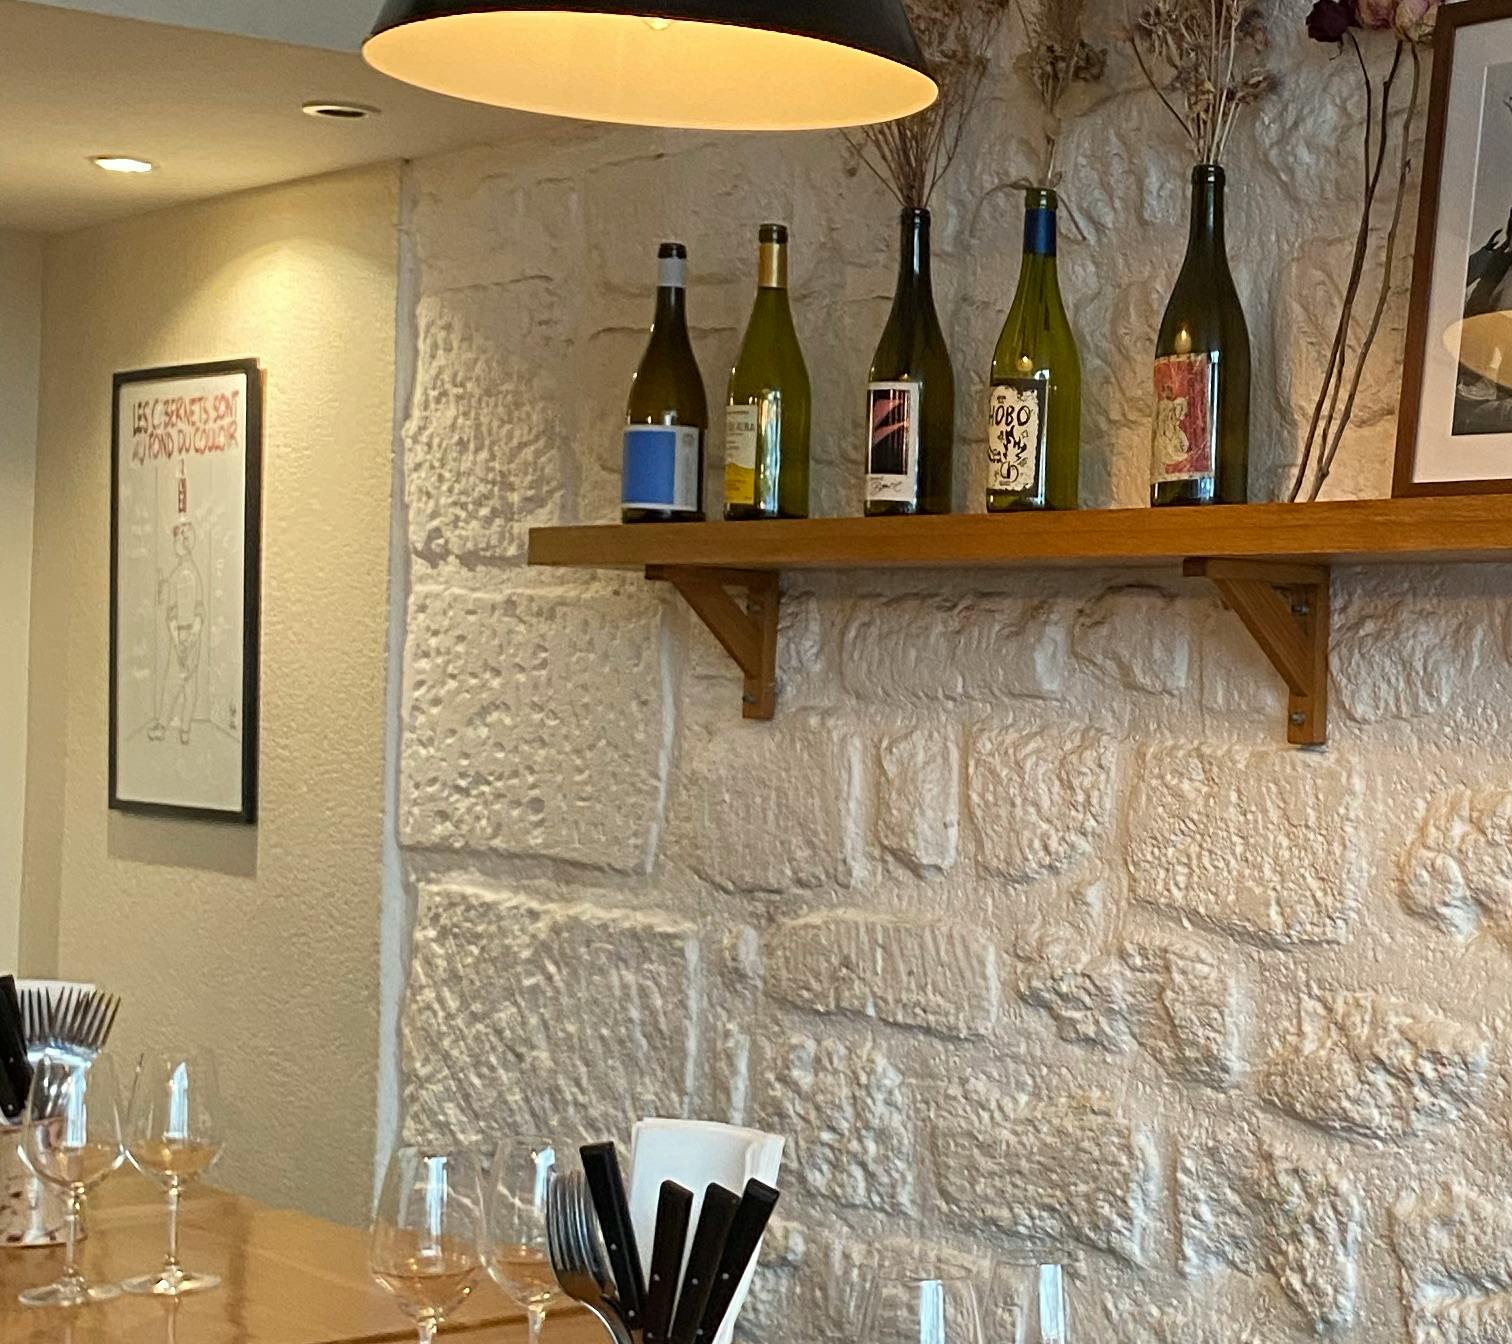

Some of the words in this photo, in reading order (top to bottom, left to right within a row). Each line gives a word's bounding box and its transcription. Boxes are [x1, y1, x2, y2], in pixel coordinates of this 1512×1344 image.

[133, 400, 149, 438] LES
[151, 395, 210, 431] CBERNETS
[214, 390, 239, 423] SONT
[988, 405, 1034, 427] HOBO
[148, 430, 174, 460] FOND
[177, 428, 192, 456] DU
